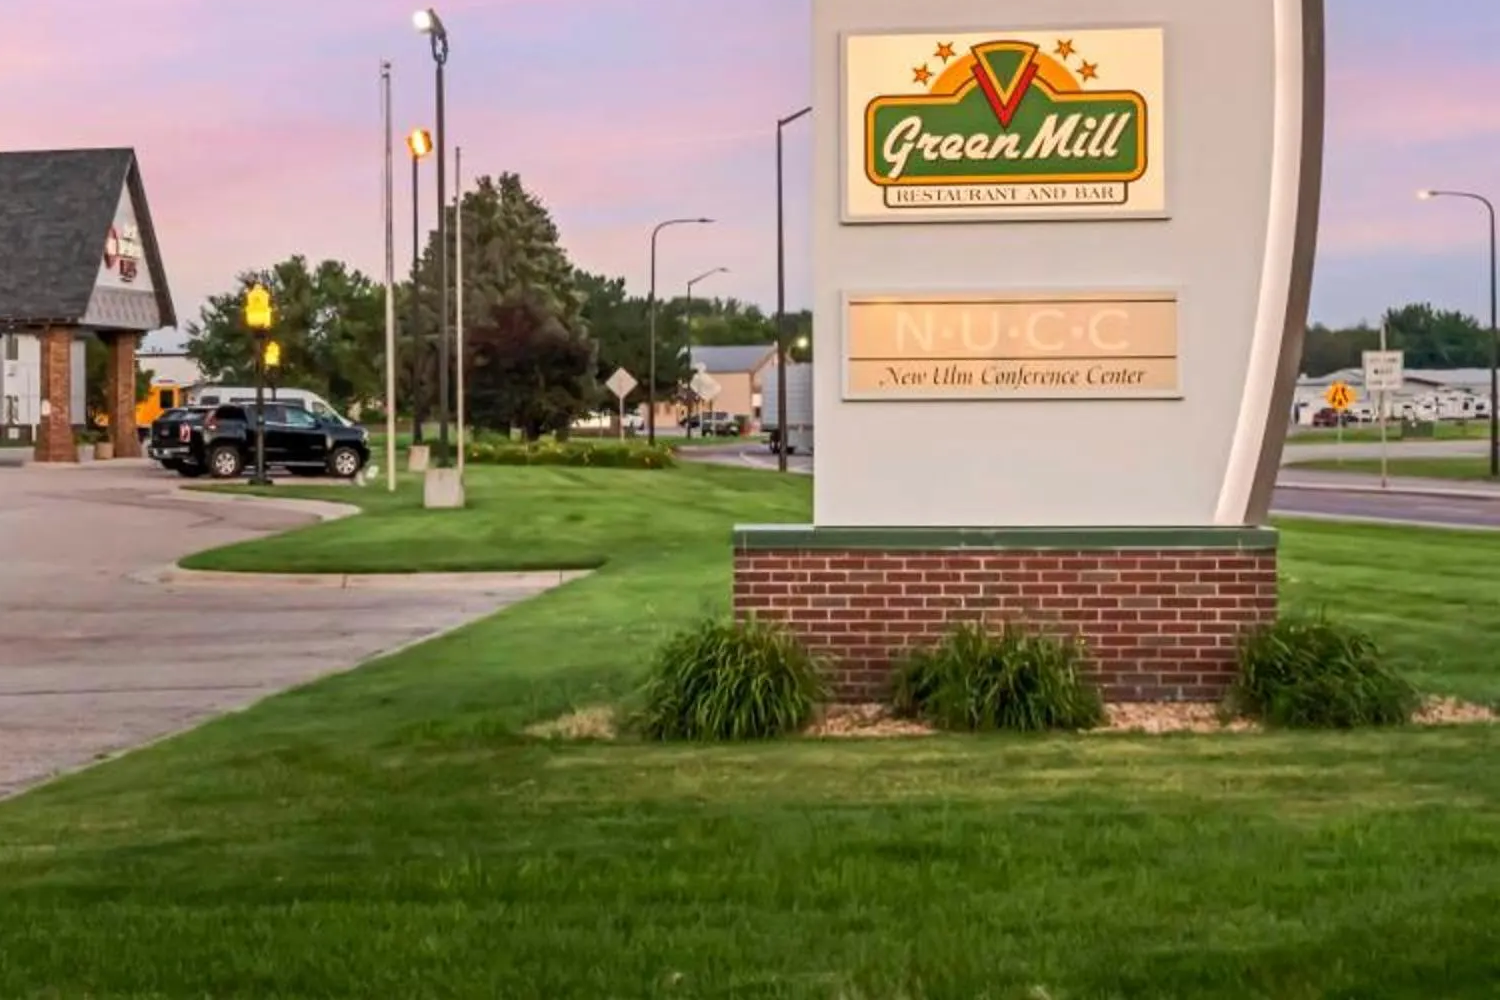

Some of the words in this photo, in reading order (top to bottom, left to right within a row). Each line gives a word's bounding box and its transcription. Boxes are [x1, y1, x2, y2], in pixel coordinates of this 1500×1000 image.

[882, 114, 1021, 179] Green
[1023, 111, 1131, 160] Mill
[897, 187, 1017, 203] RESTAURANT
[1025, 186, 1067, 201] AND
[1075, 185, 1114, 200] BAR
[879, 366, 928, 387] New
[932, 365, 974, 386] Ulm
[981, 365, 1080, 390] Conference
[1086, 366, 1148, 385] Center
